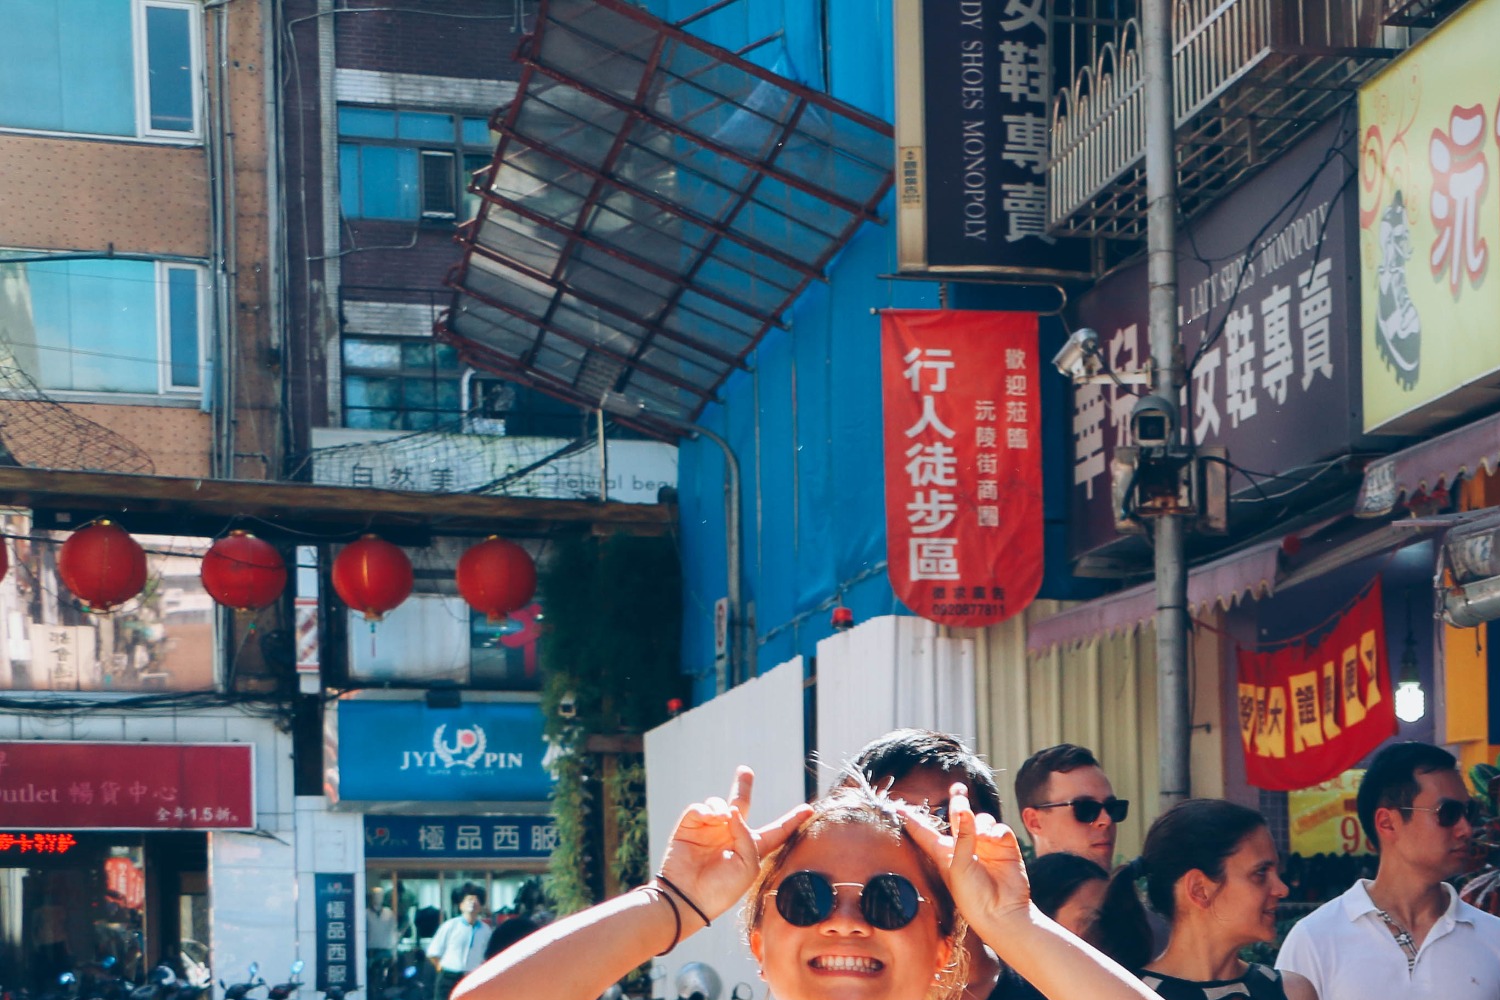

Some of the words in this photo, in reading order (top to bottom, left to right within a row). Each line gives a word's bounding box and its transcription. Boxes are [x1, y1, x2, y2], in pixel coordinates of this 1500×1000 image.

[961, 40, 984, 111] SHOES
[962, 121, 987, 242] MONOPOLY
[1260, 200, 1329, 278] MONOPOLY
[903, 347, 961, 582] 行人徒步區
[400, 751, 437, 771] JYI
[484, 752, 523, 769] PIN
